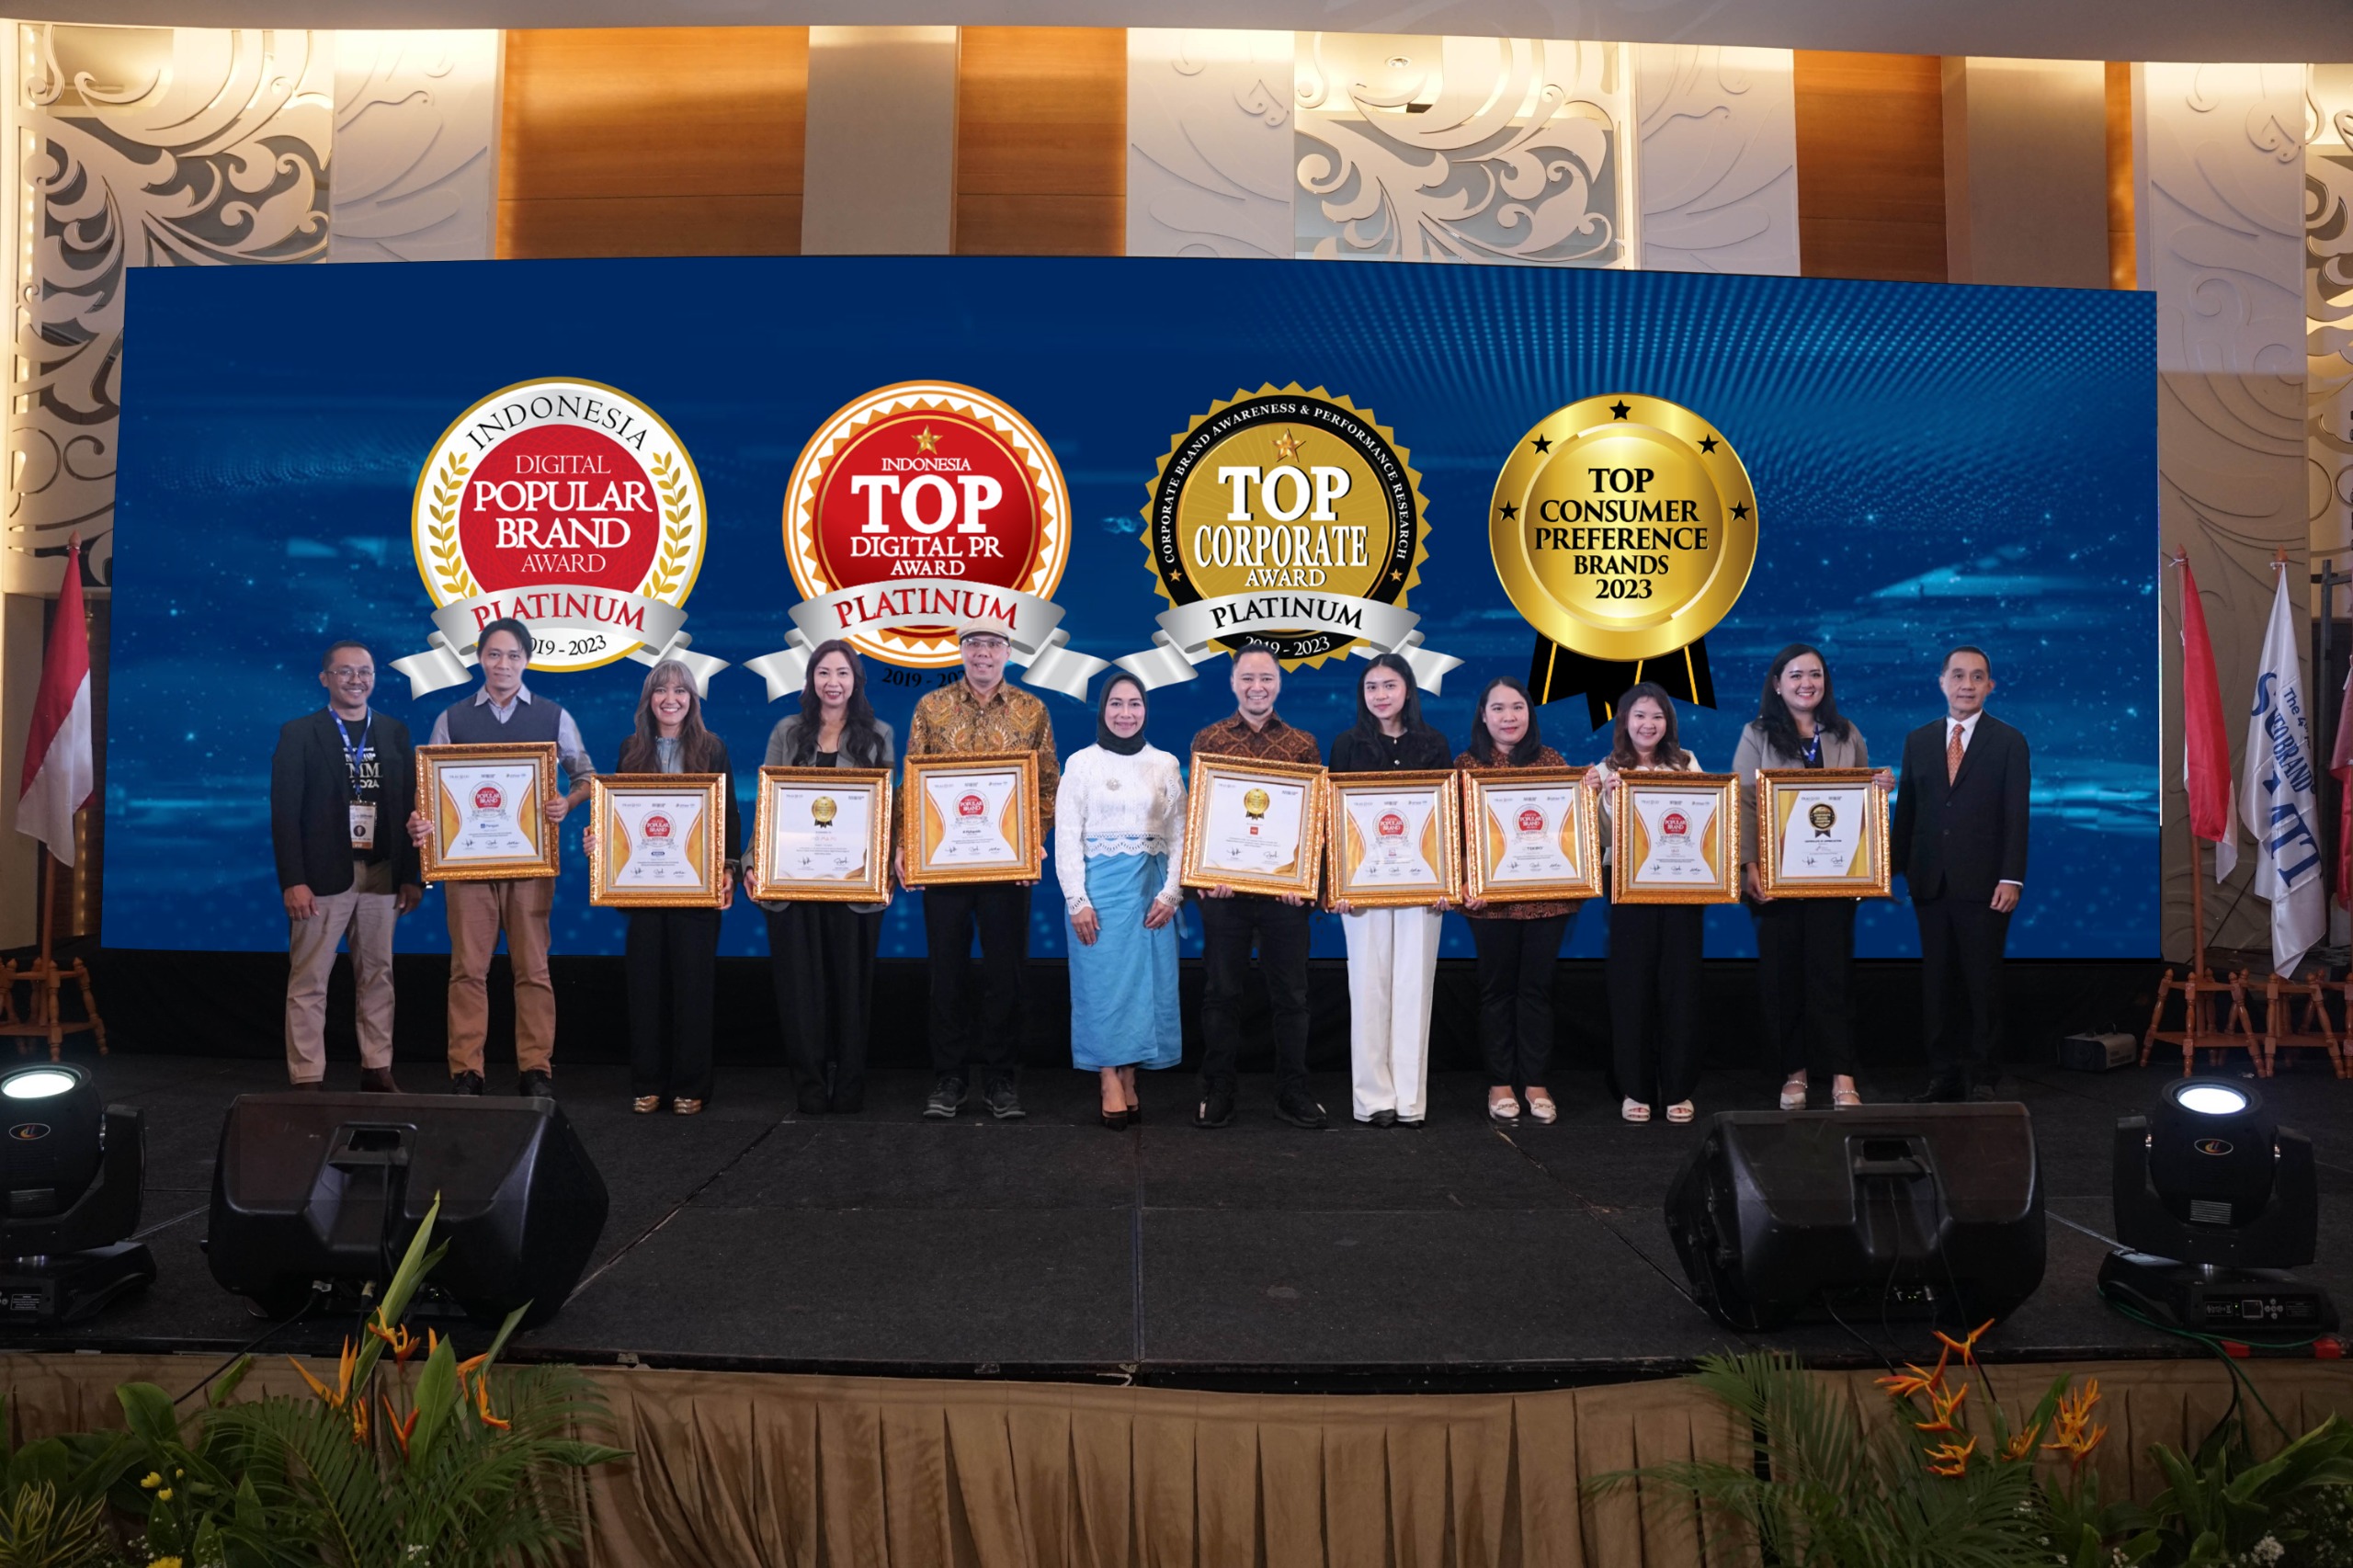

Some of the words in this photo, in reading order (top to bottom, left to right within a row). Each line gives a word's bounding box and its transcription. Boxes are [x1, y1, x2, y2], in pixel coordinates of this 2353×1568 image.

[466, 395, 648, 451] INDONESIA
[516, 455, 611, 474] DIGITAL
[881, 458, 972, 472] INDONESIA
[1161, 478, 1180, 563] CORPORATE
[1175, 433, 1211, 476] BRAND
[1212, 403, 1296, 436] AWARENESS
[1300, 404, 1310, 415] &
[1313, 407, 1398, 481] PERFORMANCE
[1392, 483, 1409, 560] RESEARCH
[1587, 468, 1654, 493] TOP
[473, 481, 653, 512] POPULAR
[850, 474, 1003, 534] TOP
[1218, 465, 1352, 521] TOP
[1540, 499, 1701, 523] CONSUMER
[495, 517, 631, 550] BRAND
[1534, 527, 1709, 551] PREFERENCE
[850, 536, 963, 557] DIGITAL
[969, 536, 1004, 558] PR
[1194, 525, 1370, 568] CORPORATE
[520, 553, 607, 573] AWARD
[890, 560, 965, 576] AWARD
[1574, 555, 1669, 575] BRANDS
[1245, 568, 1326, 587] AWARD
[1596, 578, 1653, 599] 2023
[471, 592, 645, 632] PLATINUM
[832, 587, 1017, 631] PLATINUM
[1209, 597, 1362, 631] PLATINUM
[568, 634, 607, 655] 2023
[1294, 636, 1330, 656] 2023
[882, 667, 922, 687] 2019
[2283, 687, 2301, 716] The
